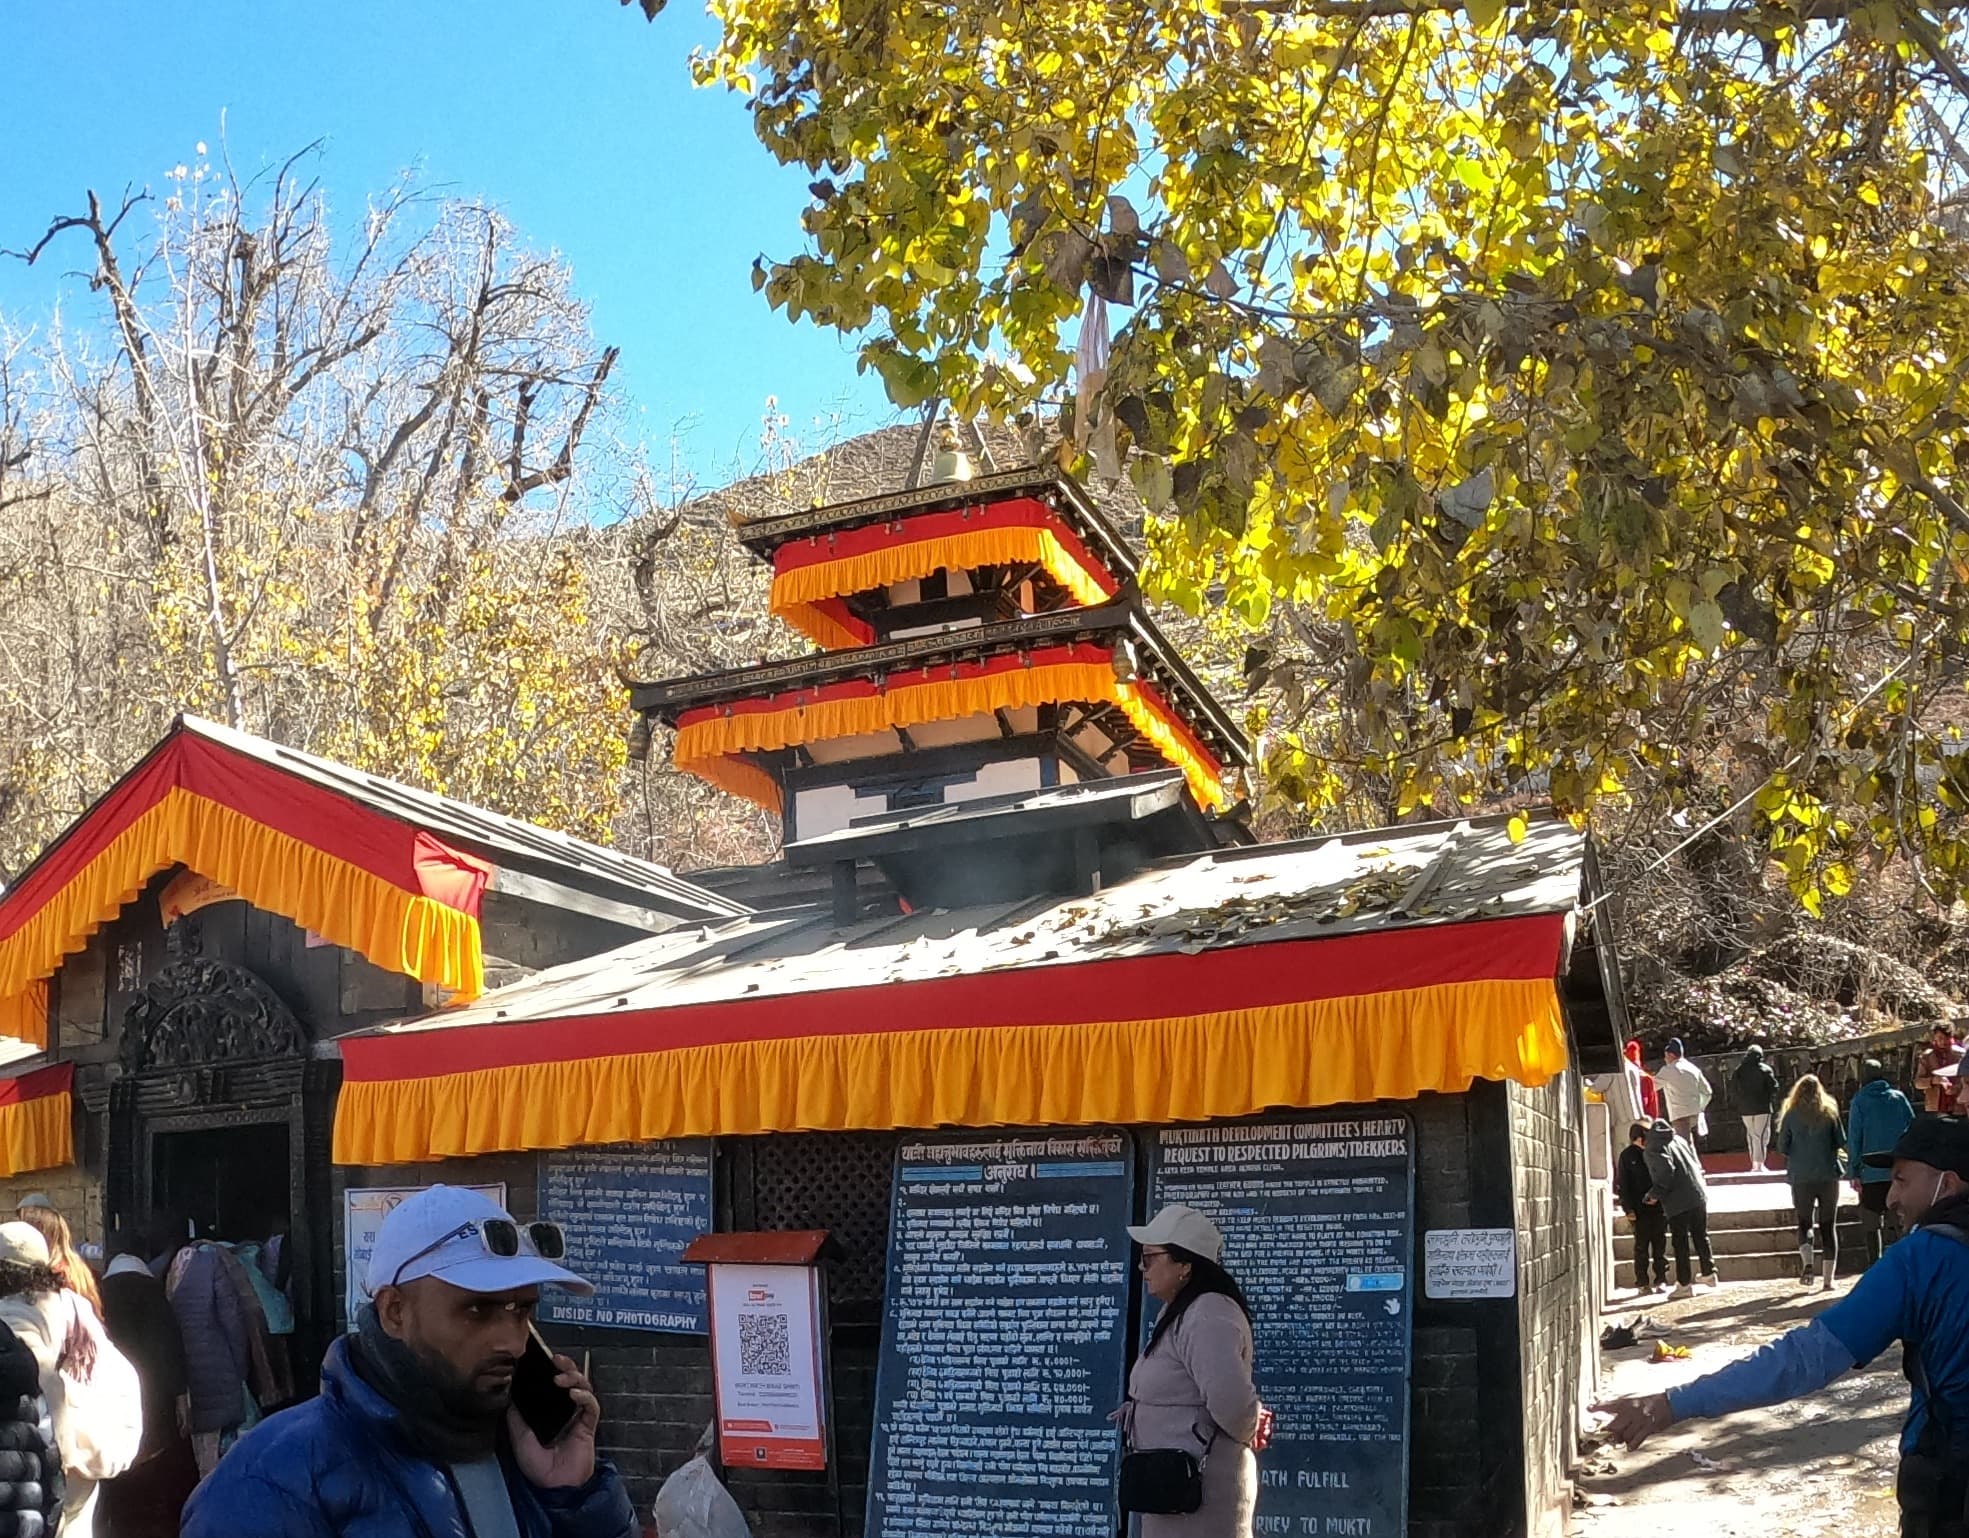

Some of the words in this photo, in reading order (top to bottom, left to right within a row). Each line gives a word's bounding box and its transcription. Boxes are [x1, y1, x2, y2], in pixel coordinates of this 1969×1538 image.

[1159, 1127, 1220, 1145] MUKTINATH
[1221, 1125, 1292, 1143] DEVELOPMENT
[1293, 1121, 1361, 1141] COMMITTEE'S
[1362, 1118, 1406, 1137] HEARTY
[1163, 1146, 1211, 1165] REQUEST
[1212, 1147, 1226, 1163] TO
[1227, 1143, 1291, 1163] RESPECTED
[552, 1306, 593, 1322] INSIDE
[596, 1310, 613, 1323] NO
[616, 1311, 697, 1330] PHOTOGRAPHY
[1297, 1470, 1350, 1488] FULFILL
[1300, 1517, 1317, 1534] TO
[1326, 1517, 1371, 1537] MUKTI
